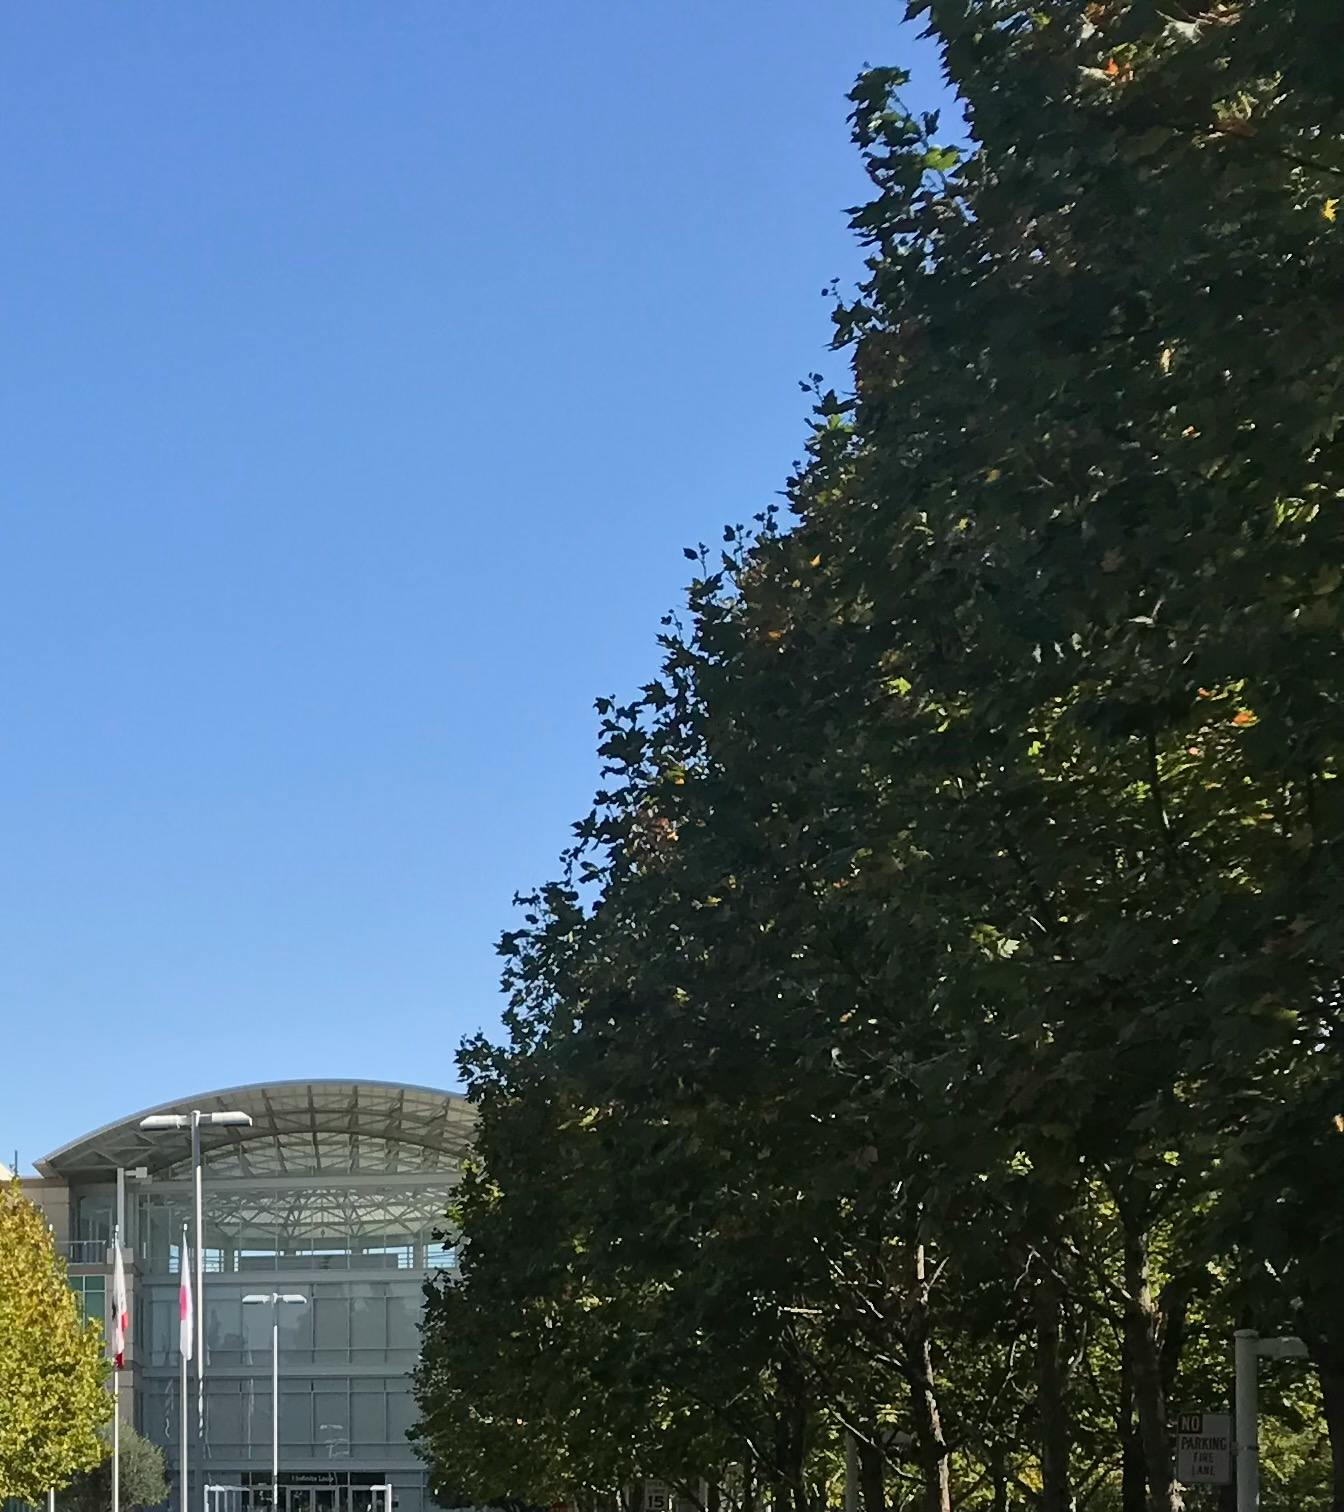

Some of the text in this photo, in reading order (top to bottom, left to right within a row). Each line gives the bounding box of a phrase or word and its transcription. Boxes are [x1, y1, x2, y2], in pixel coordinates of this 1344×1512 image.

[1181, 1415, 1200, 1431] NO
[1181, 1436, 1227, 1450] PARKING
[648, 1495, 664, 1508] 15
